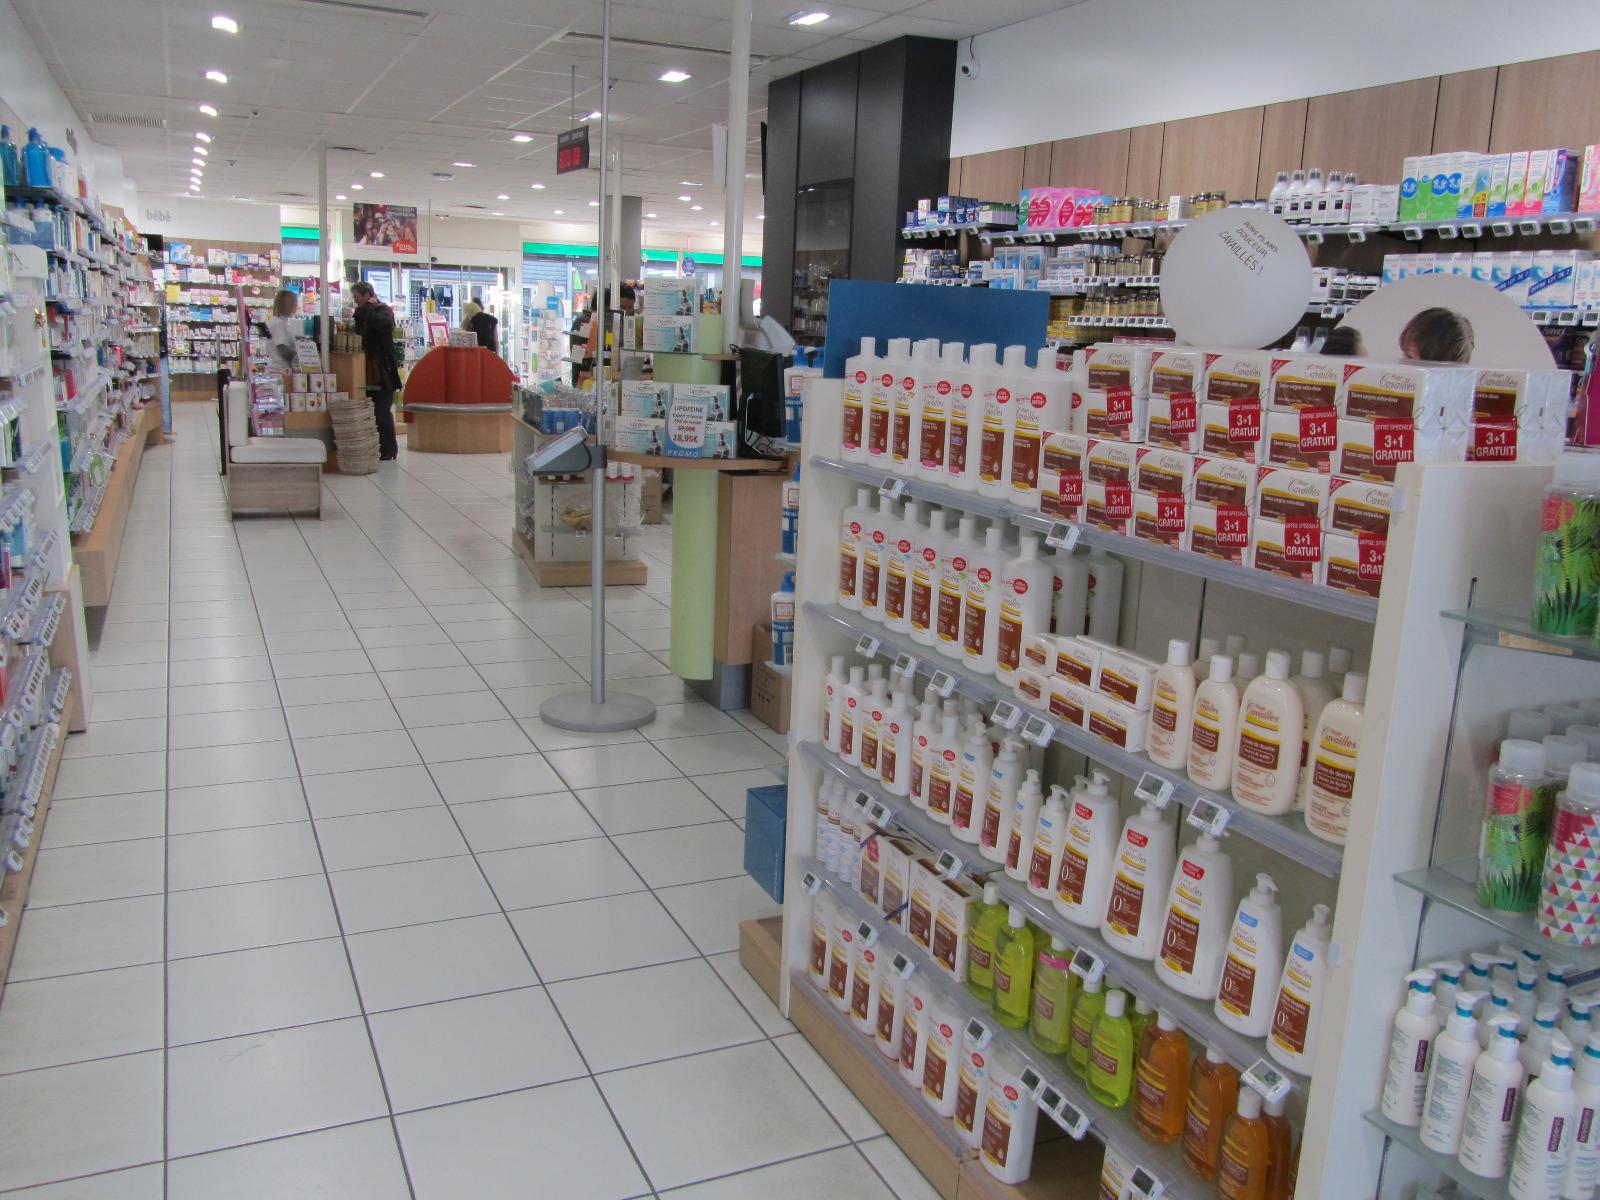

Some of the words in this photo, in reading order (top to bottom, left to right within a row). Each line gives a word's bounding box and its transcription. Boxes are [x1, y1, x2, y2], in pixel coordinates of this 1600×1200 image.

[146, 208, 171, 222] bébé
[1235, 228, 1268, 257] DOUCEUR
[1258, 234, 1279, 253] PLANS
[1113, 400, 1125, 410] 3+1
[1107, 411, 1131, 421] GRATUIT
[1176, 407, 1189, 418] 3+1
[1171, 419, 1195, 429] GRATUIT
[1236, 414, 1252, 426] 3+1
[1230, 426, 1260, 437] GRATUIT
[1309, 422, 1327, 435] 3+1
[1300, 436, 1336, 447] GRATUIT
[1384, 435, 1404, 448] 3+1
[1485, 432, 1506, 445] 3+1
[667, 449, 699, 457] PROMO
[1375, 450, 1413, 461] GRATUIT
[1475, 445, 1515, 456] GRATUIT
[1065, 483, 1076, 493] 3+1
[1060, 494, 1082, 503] GRATUIT
[1112, 495, 1124, 504] 3+1
[1106, 506, 1130, 515] GRATUIT
[1164, 506, 1178, 517] 3+1
[1158, 518, 1184, 528] GRATUIT
[1224, 519, 1239, 531] 3+1
[1217, 532, 1247, 543] GRATUIT
[1293, 532, 1310, 545] 3+1
[1286, 546, 1319, 556] GRATUIT
[1360, 564, 1384, 574] GRAT
